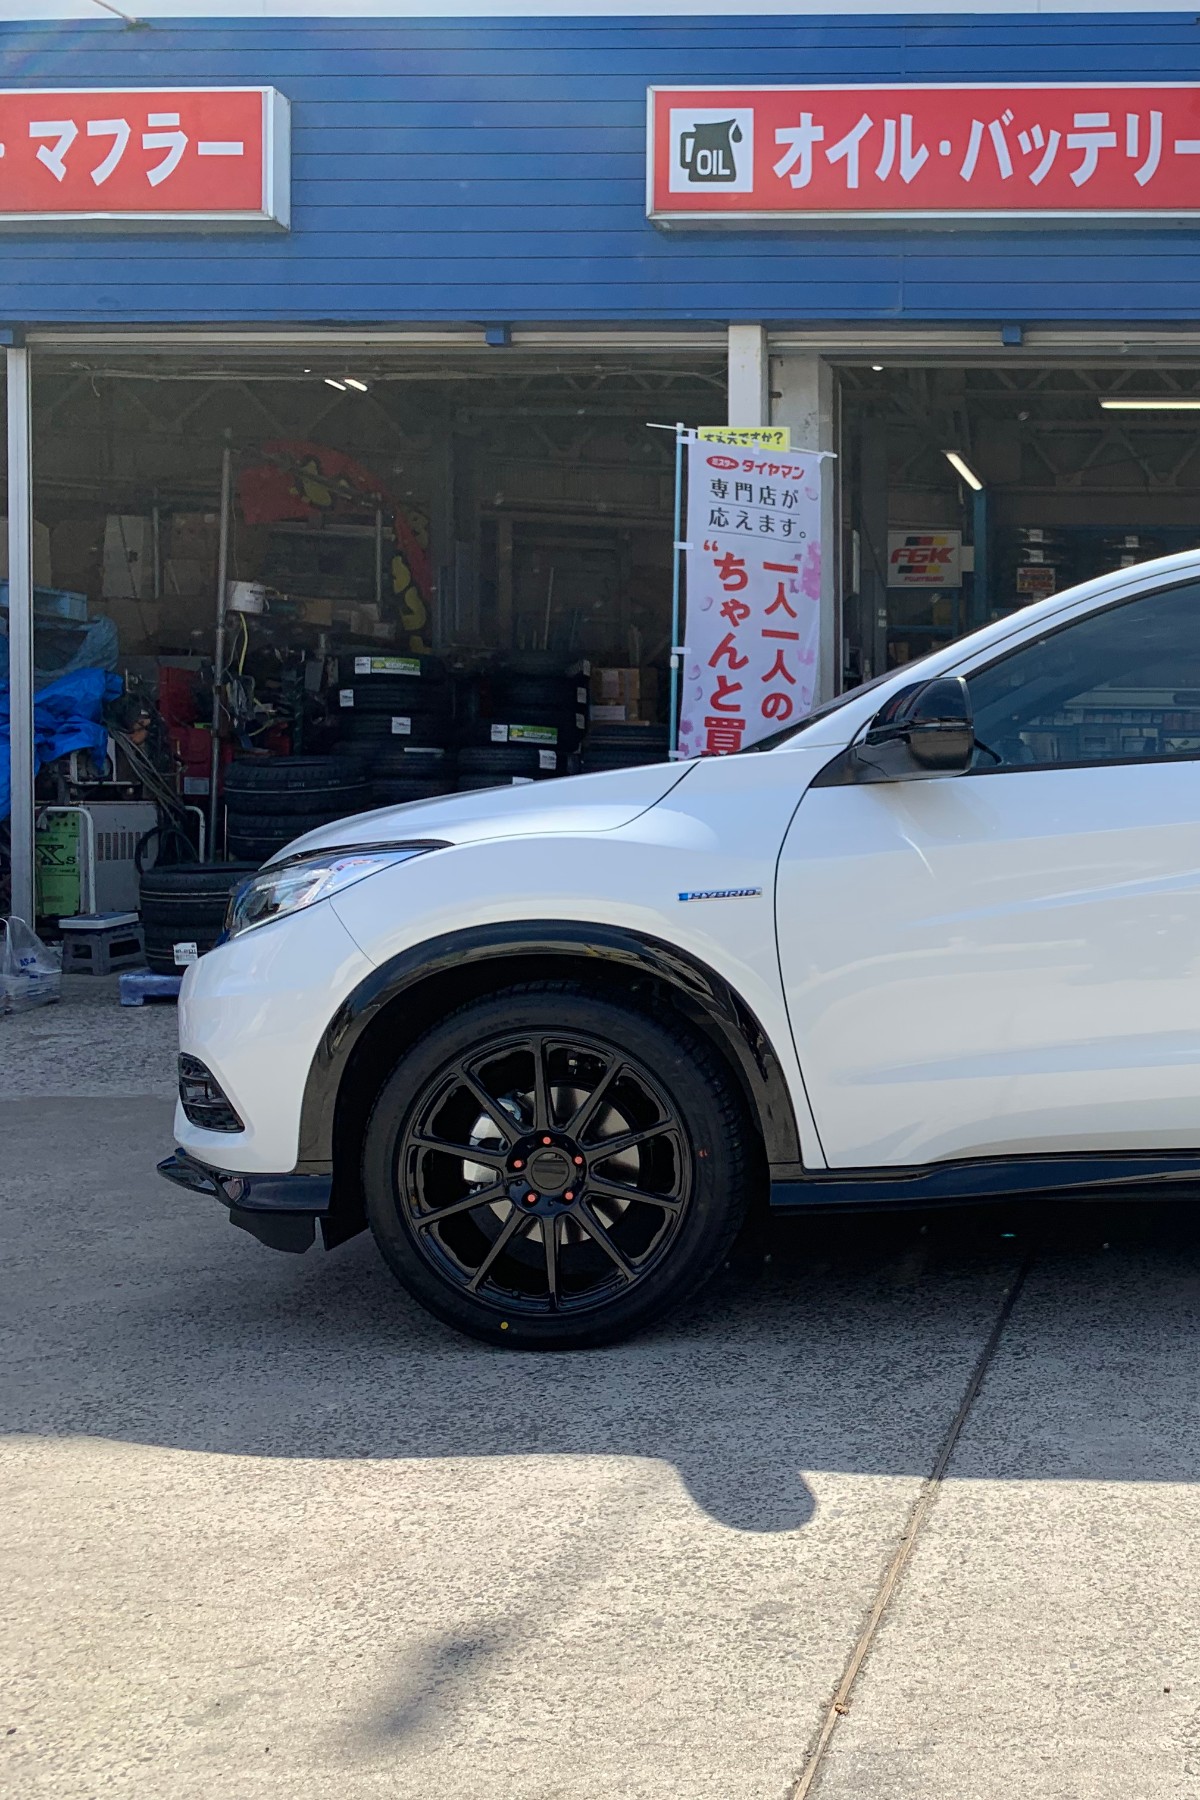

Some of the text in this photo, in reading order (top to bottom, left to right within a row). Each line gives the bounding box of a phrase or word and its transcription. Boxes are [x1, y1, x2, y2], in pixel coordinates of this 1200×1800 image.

[698, 149, 730, 175] OIL
[710, 478, 799, 509] 専門店が
[708, 507, 807, 537] 応えます。
[761, 561, 799, 721] 一人一人の
[690, 889, 757, 900] HYBRID
